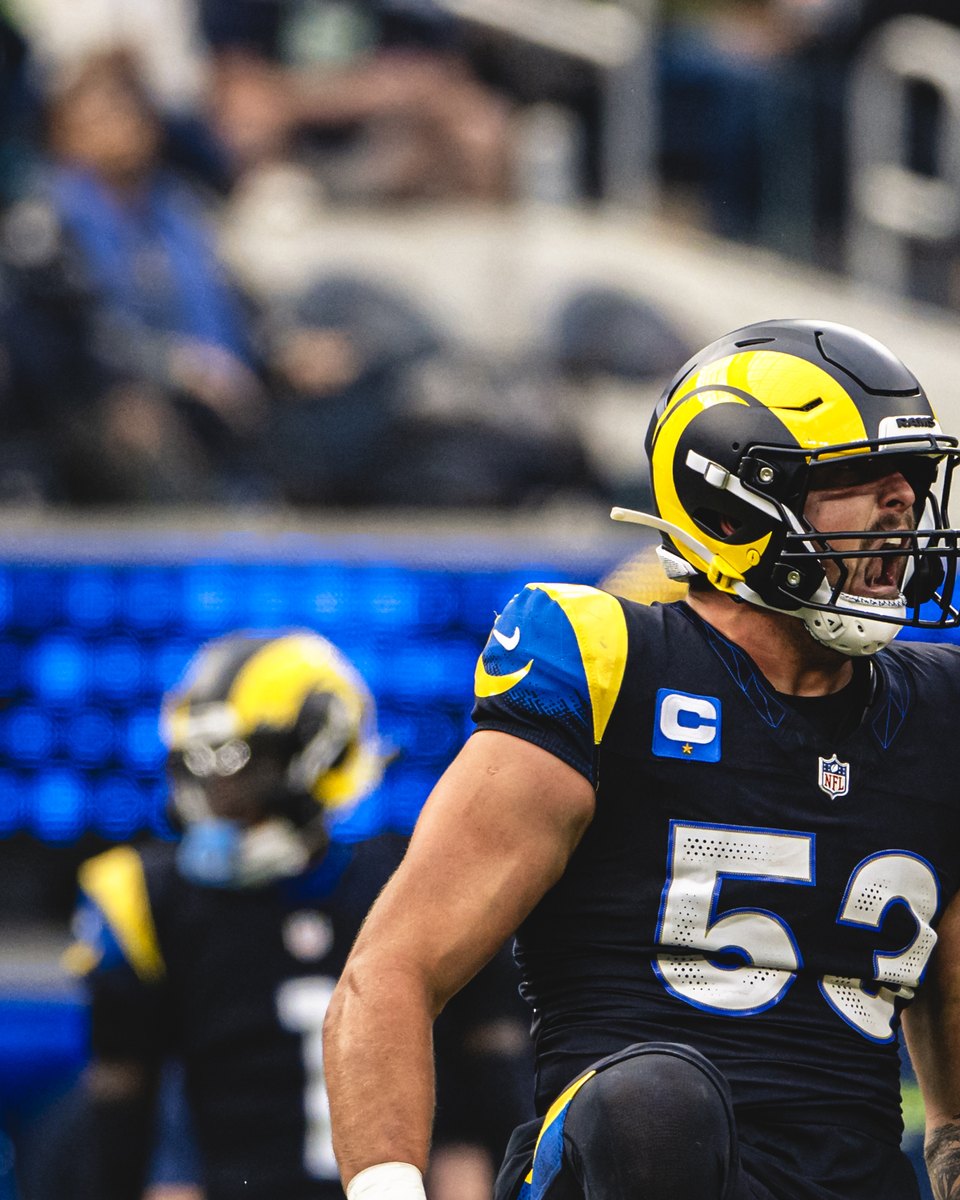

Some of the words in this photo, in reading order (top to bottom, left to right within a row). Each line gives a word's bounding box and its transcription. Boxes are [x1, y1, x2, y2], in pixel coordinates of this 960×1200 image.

[895, 417, 936, 429] RAMS
[660, 693, 717, 745] C
[824, 773, 845, 791] NFL
[650, 818, 942, 1045] 53
